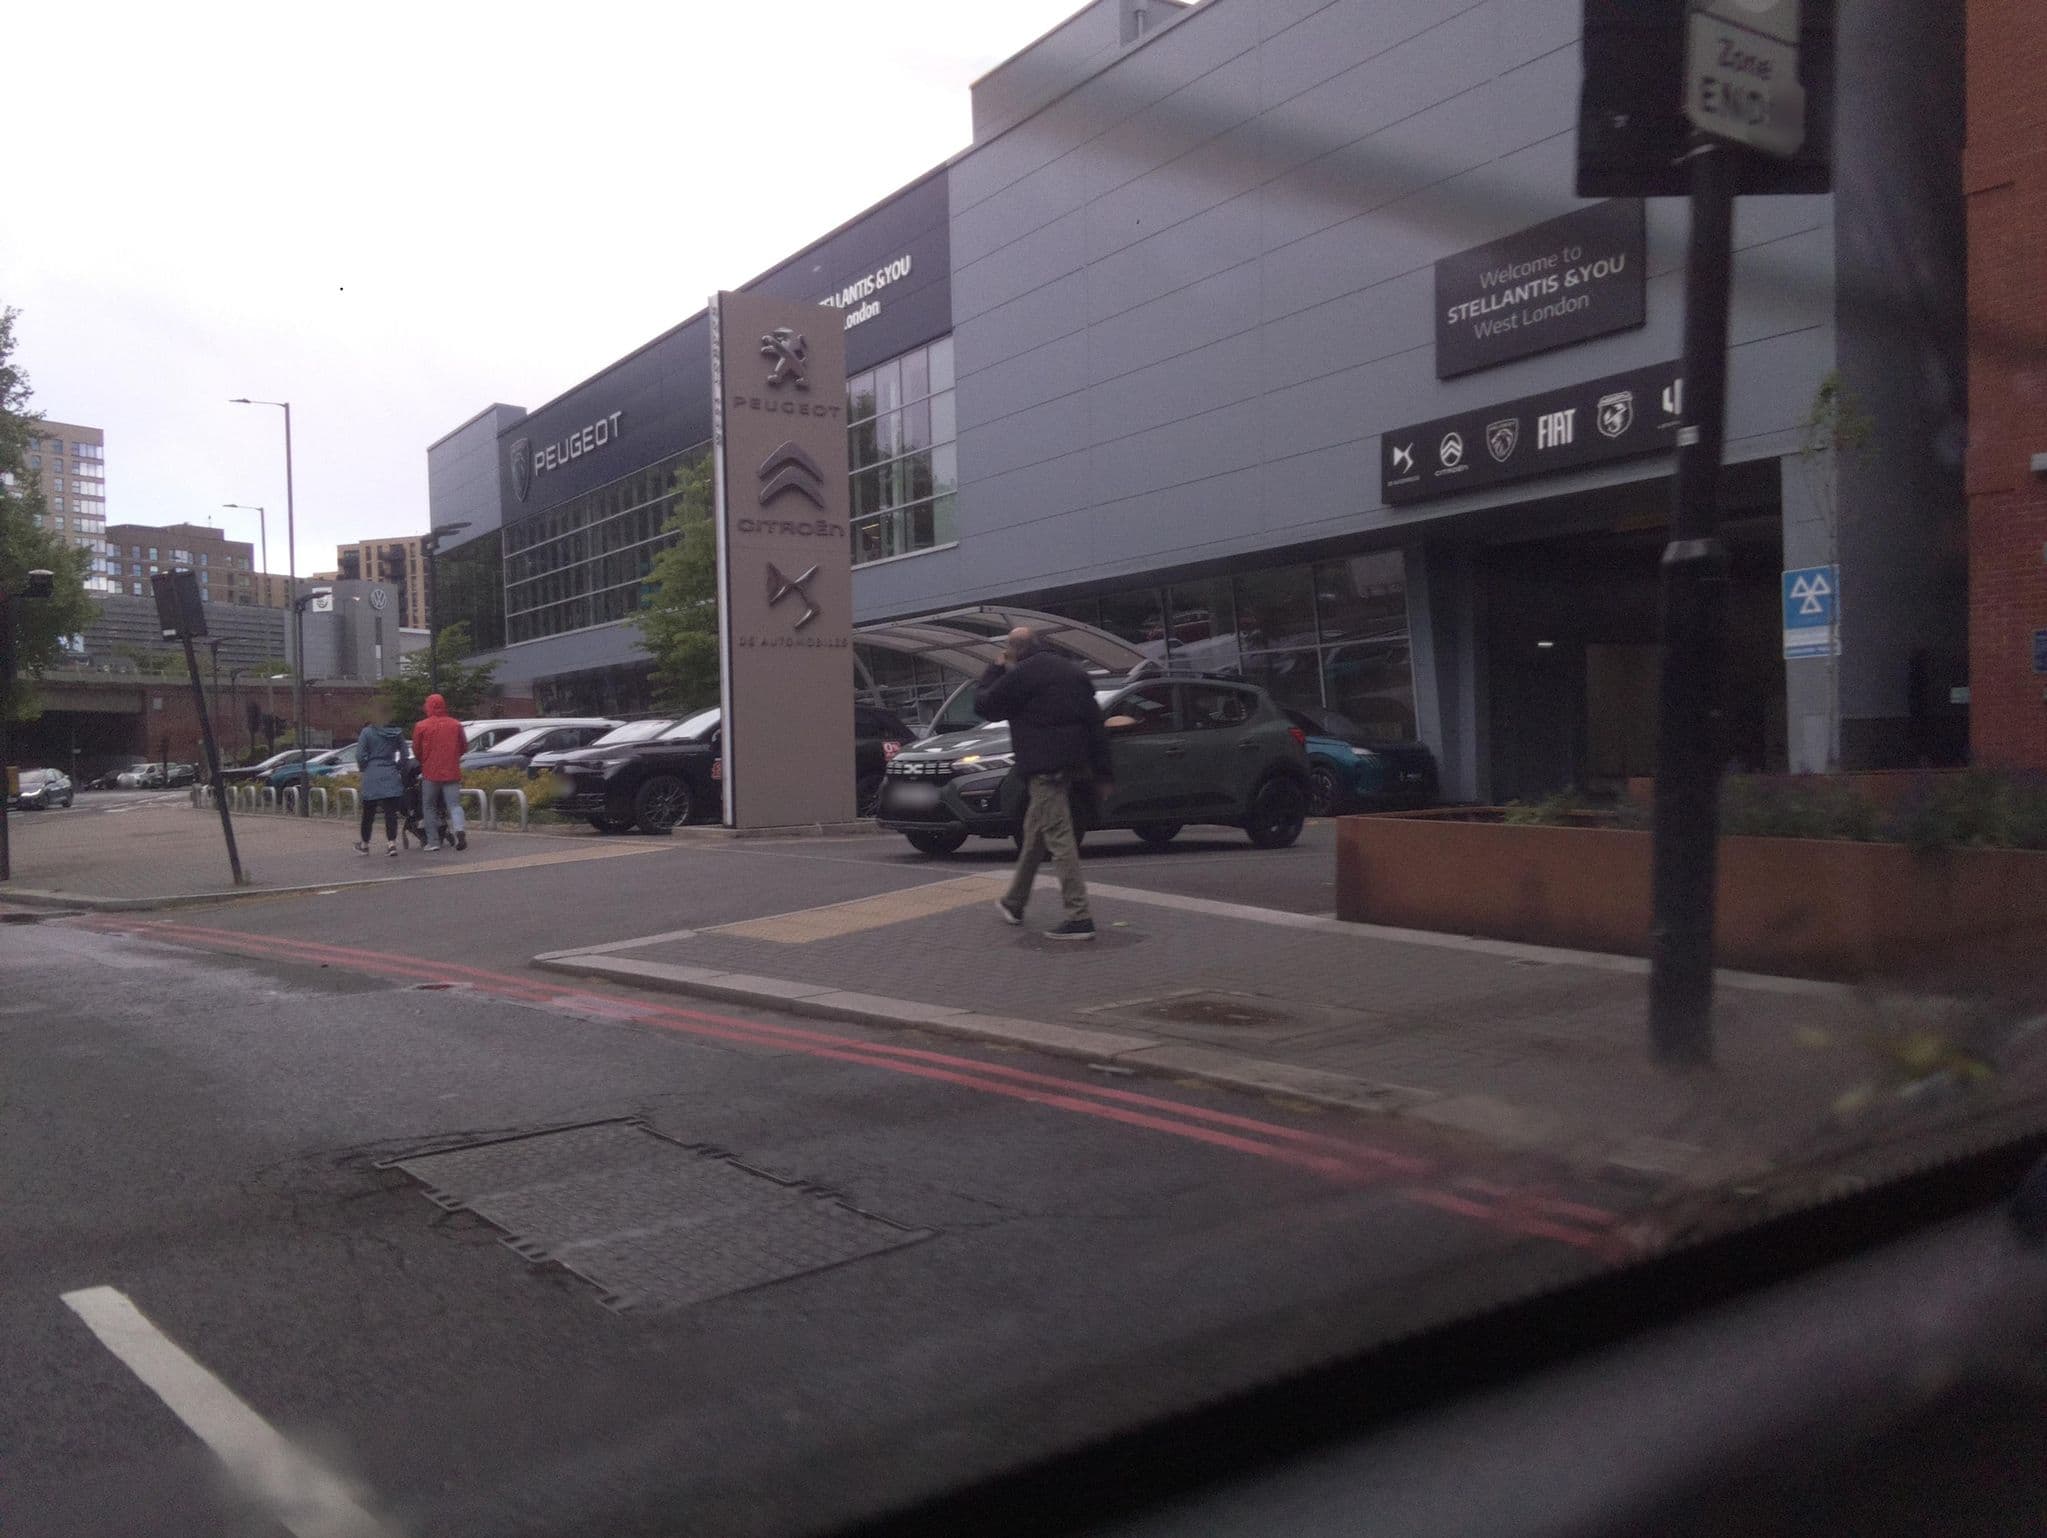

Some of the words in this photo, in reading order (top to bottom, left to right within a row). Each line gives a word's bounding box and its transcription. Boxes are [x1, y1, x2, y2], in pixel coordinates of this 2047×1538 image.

[1718, 37, 1772, 81] Zone
[1480, 253, 1559, 289] Welcome
[1562, 247, 1582, 263] to
[843, 301, 881, 331] ondon
[1447, 274, 1560, 326] STELLANTIS
[1473, 312, 1520, 340] West
[1521, 294, 1590, 326] London
[733, 396, 842, 419] PEUGEOT
[1537, 407, 1578, 450] FIAT
[534, 410, 622, 477] PEUGEOT
